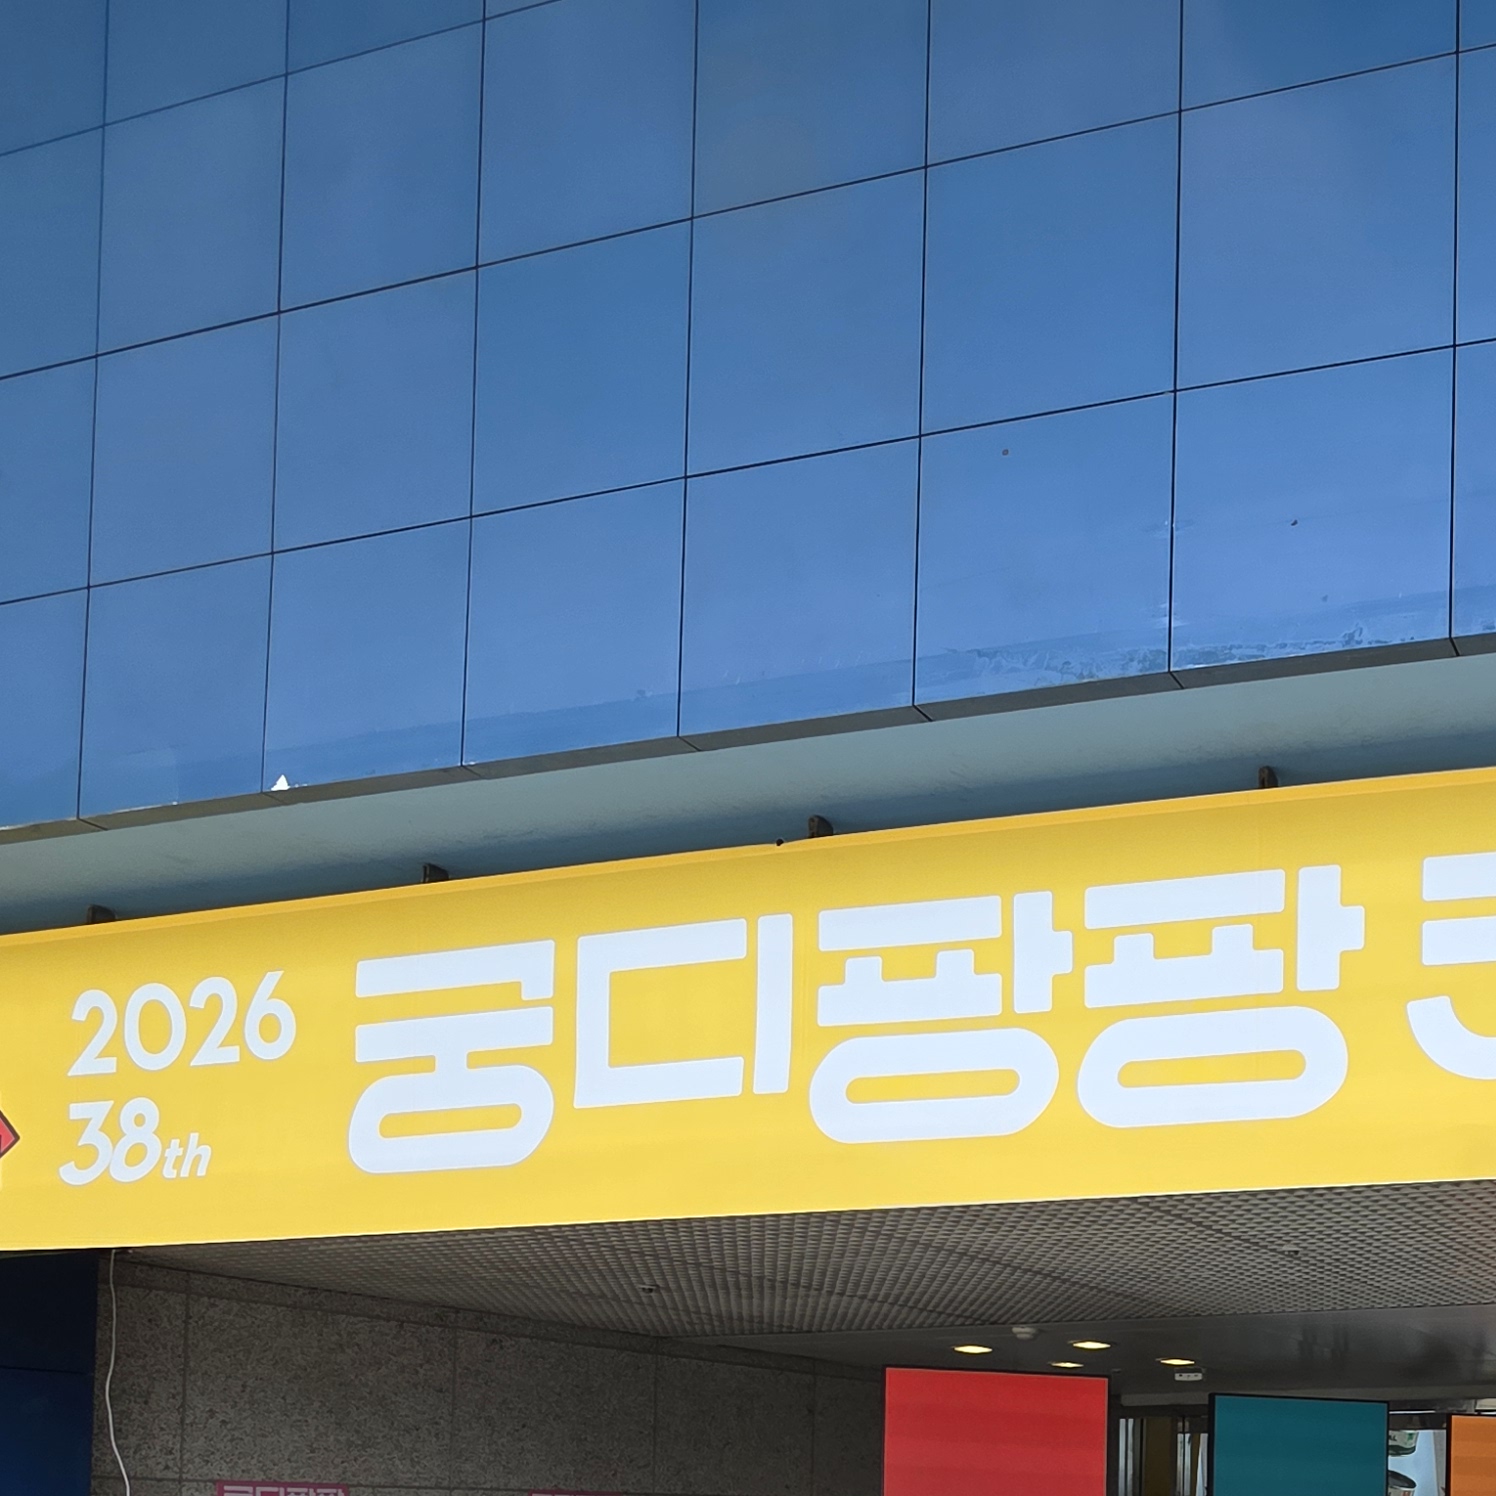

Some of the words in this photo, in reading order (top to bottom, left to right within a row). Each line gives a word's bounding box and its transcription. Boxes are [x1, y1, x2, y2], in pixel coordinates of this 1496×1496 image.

[68, 970, 296, 1077] 2026
[347, 864, 1366, 1174] 궁디팡팡
[59, 1096, 212, 1187] 38th
